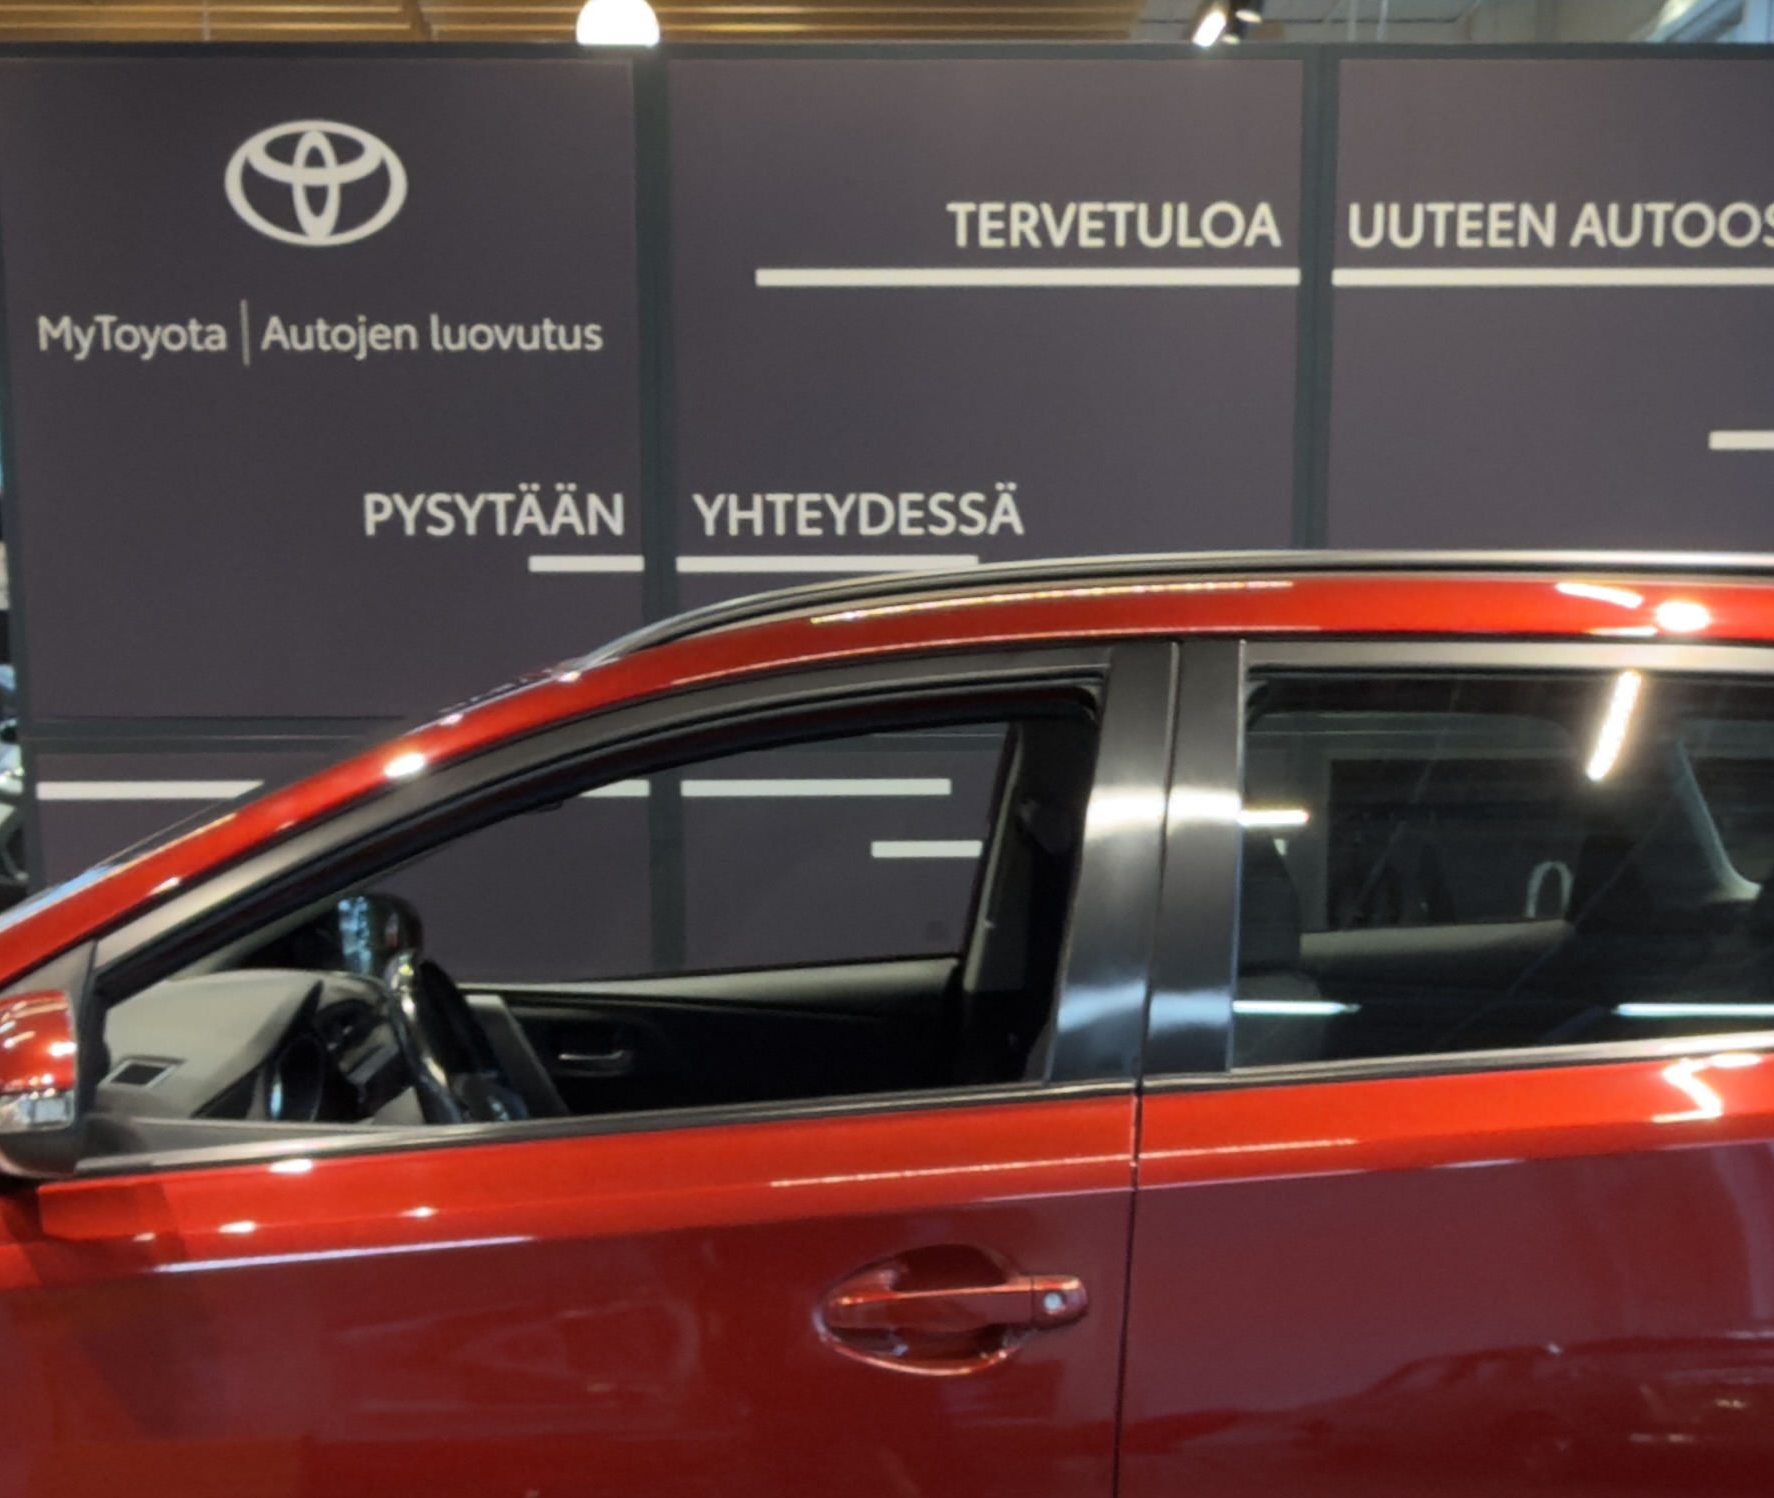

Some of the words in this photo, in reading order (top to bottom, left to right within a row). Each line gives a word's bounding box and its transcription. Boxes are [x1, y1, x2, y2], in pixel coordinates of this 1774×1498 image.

[946, 201, 1283, 249] TERVETULOA
[1347, 201, 1556, 249] UUTEEN
[37, 315, 227, 361] MyToyota
[261, 315, 418, 361] Autojen
[430, 313, 604, 353] luovutus
[363, 482, 625, 537] PYSYTÄÄN
[692, 482, 1025, 537] YHTEYDESSÄ
